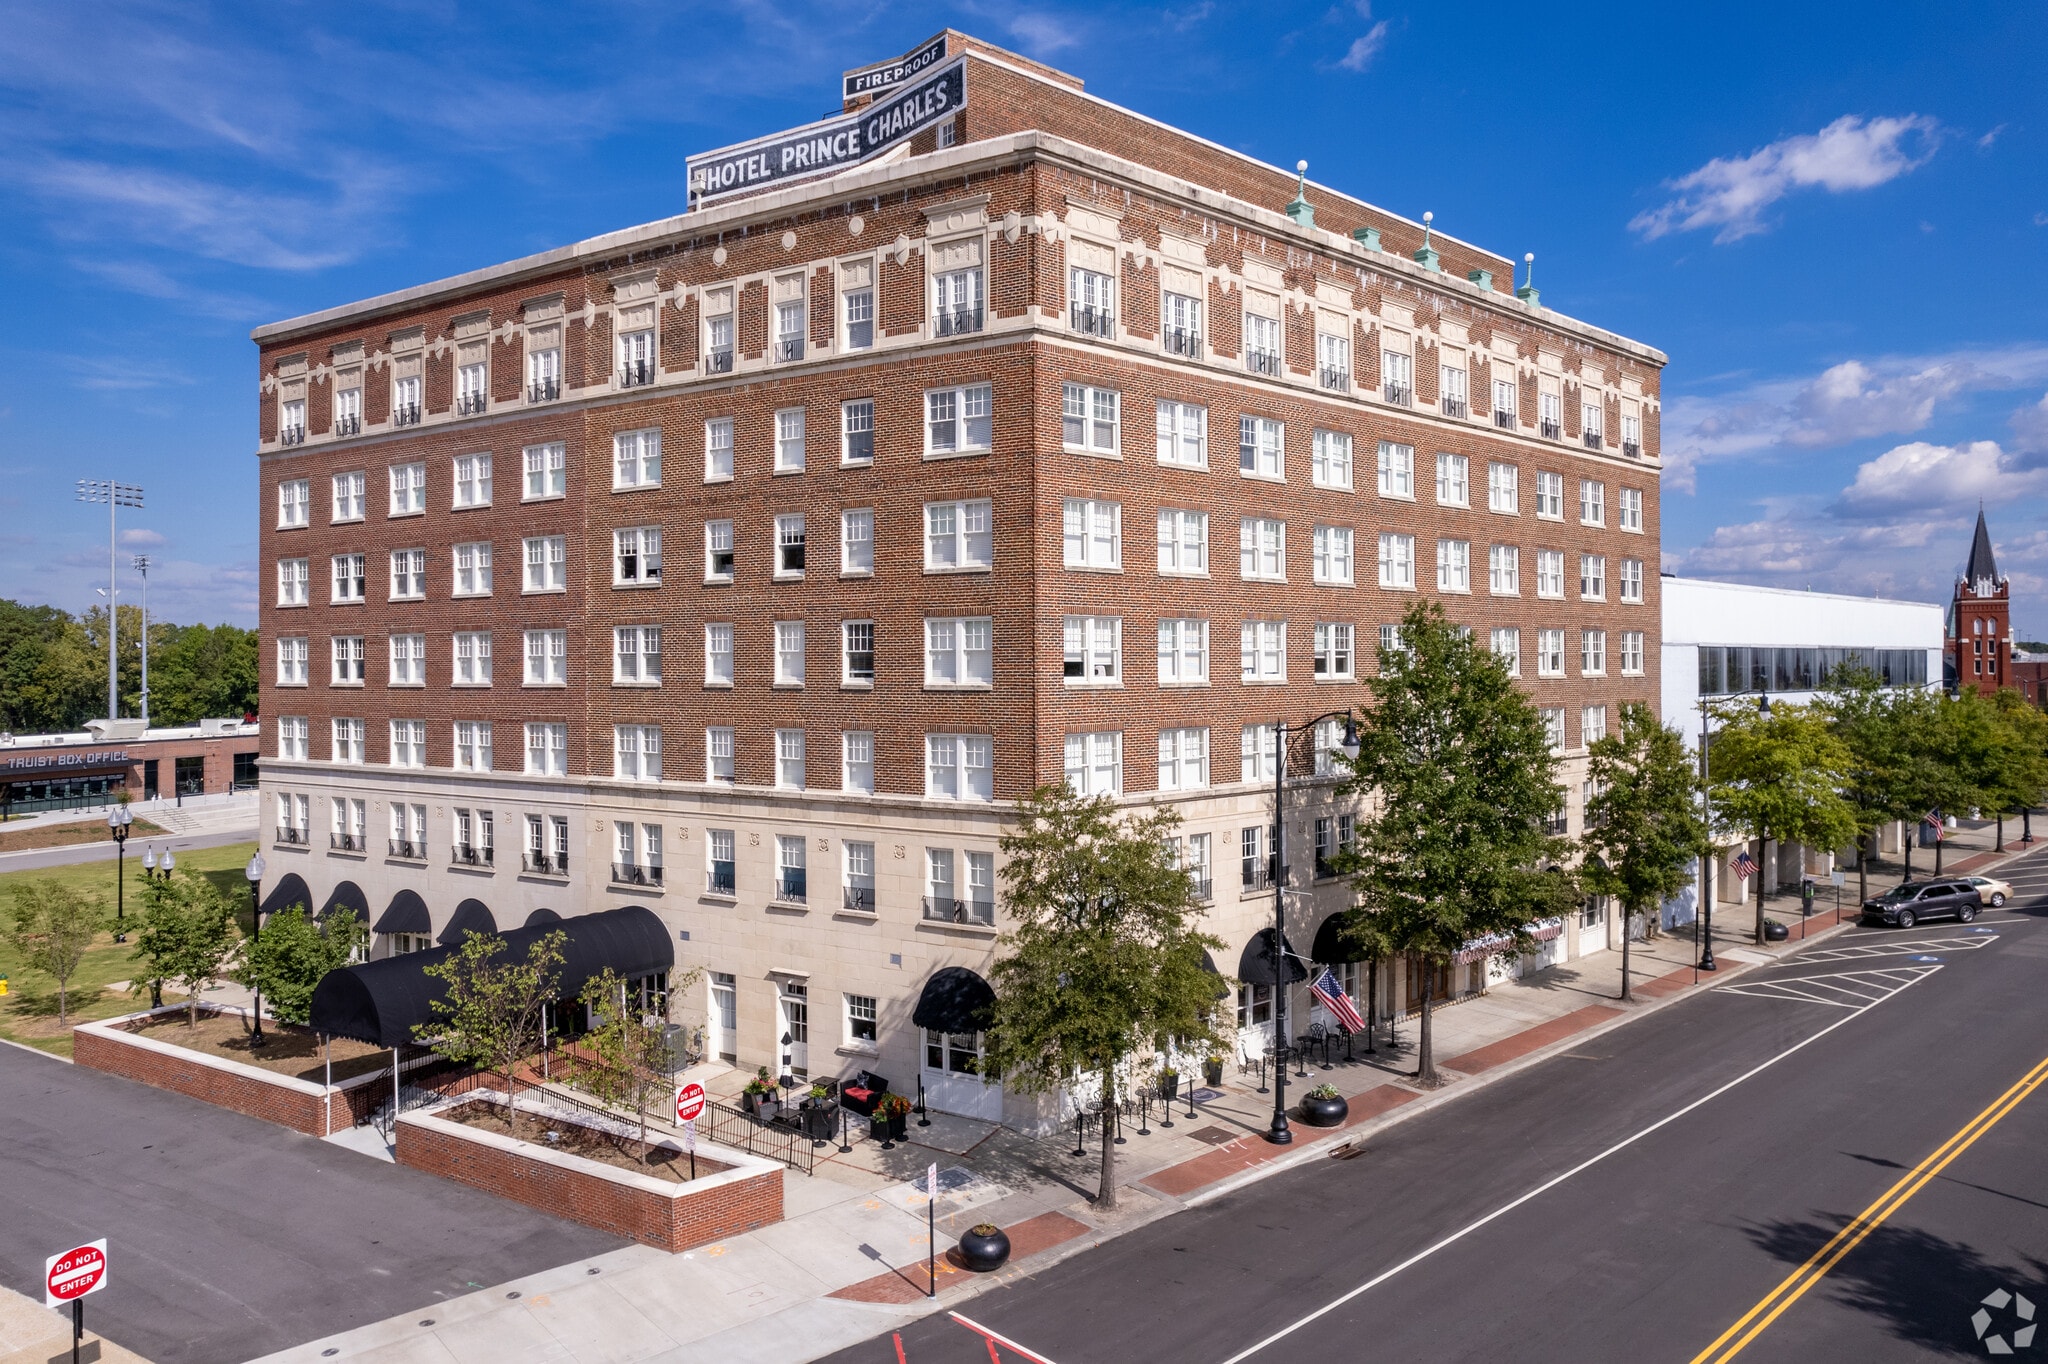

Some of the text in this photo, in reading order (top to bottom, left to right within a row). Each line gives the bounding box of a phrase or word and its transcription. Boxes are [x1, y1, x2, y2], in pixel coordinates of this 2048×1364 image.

[856, 46, 938, 90] FIREPROOF
[706, 80, 947, 191] HOTEL PRINCE CHARLES
[8, 751, 129, 769] TRUIST BOX OFFICE
[680, 1087, 701, 1101] DO NOT
[683, 1104, 700, 1116] ENTER
[56, 1251, 97, 1273] DO NOT
[60, 1274, 93, 1294] ENTER
